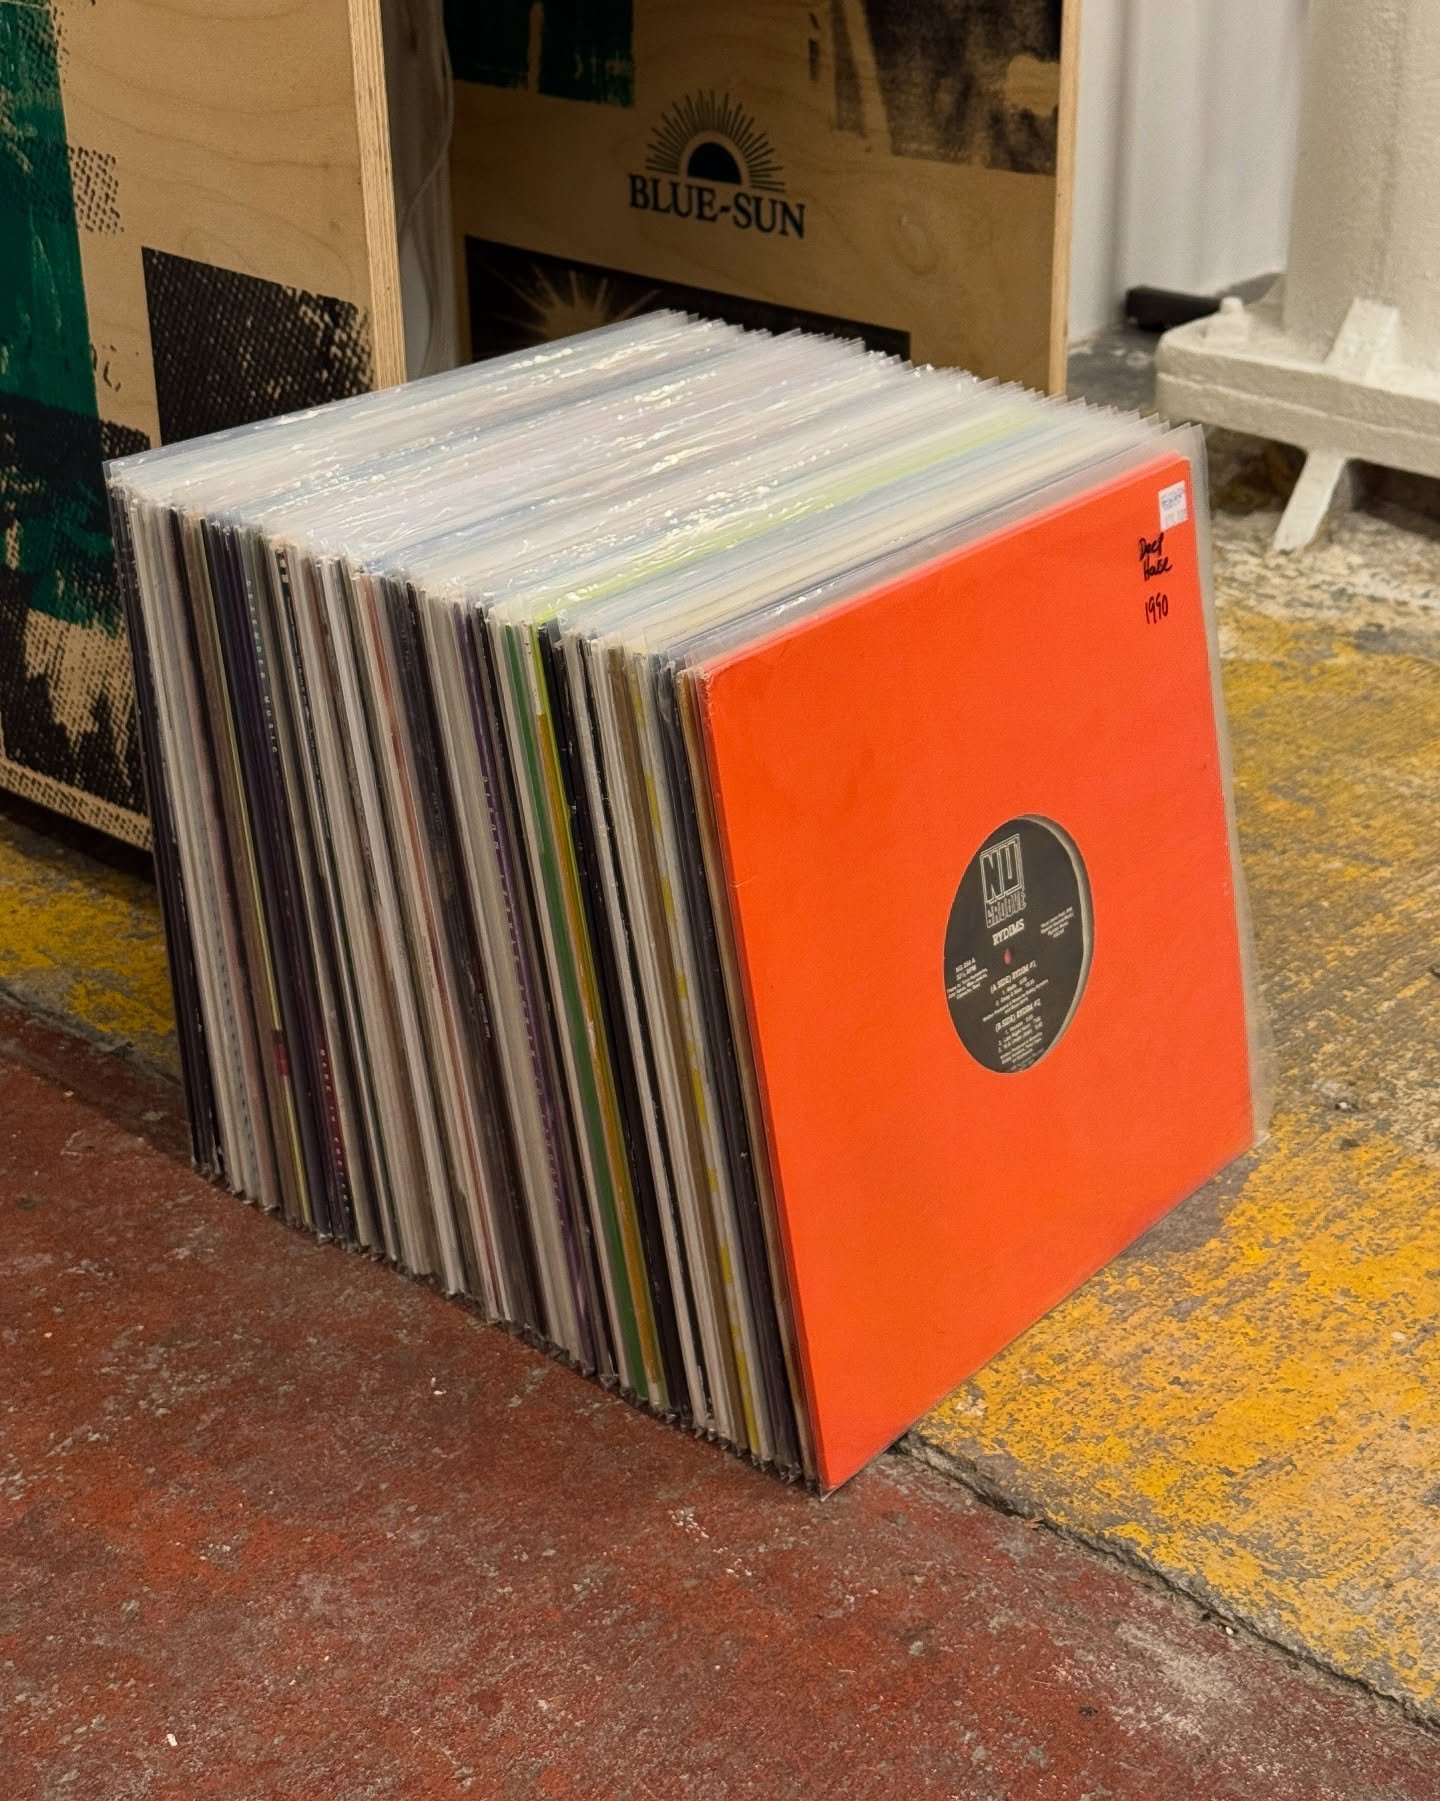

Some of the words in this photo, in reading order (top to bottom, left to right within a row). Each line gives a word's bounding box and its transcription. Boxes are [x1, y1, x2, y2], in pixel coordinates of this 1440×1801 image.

[628, 172, 806, 239] BLUE-SUN
[1145, 592, 1168, 624] 1990
[979, 837, 1022, 904] NU
[992, 918, 1024, 946] RYDIMS
